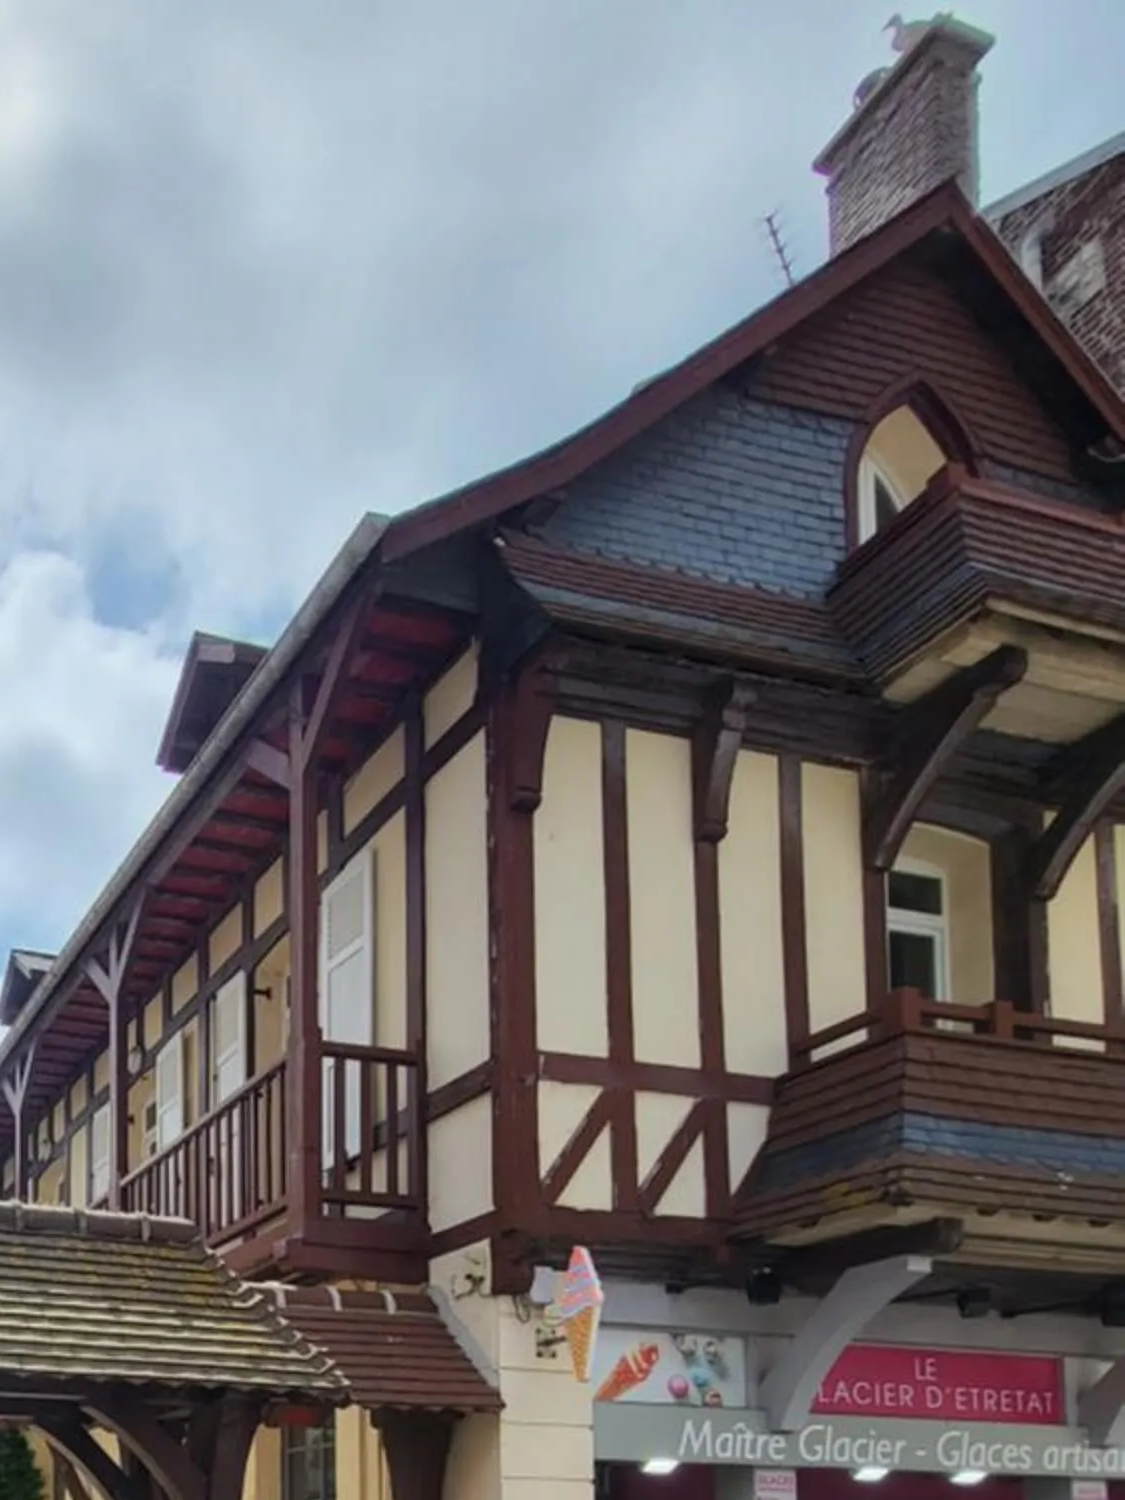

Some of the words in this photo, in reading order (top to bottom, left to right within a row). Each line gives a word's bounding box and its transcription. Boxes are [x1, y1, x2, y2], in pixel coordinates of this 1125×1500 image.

[914, 1357, 938, 1382] LE
[818, 1380, 914, 1408] LACIER
[925, 1385, 1053, 1414] D'ETRETAT
[678, 1419, 786, 1461] Maître
[798, 1424, 908, 1464] Glacier
[936, 1430, 1032, 1470] Glaces
[1043, 1440, 1125, 1473] artisa
